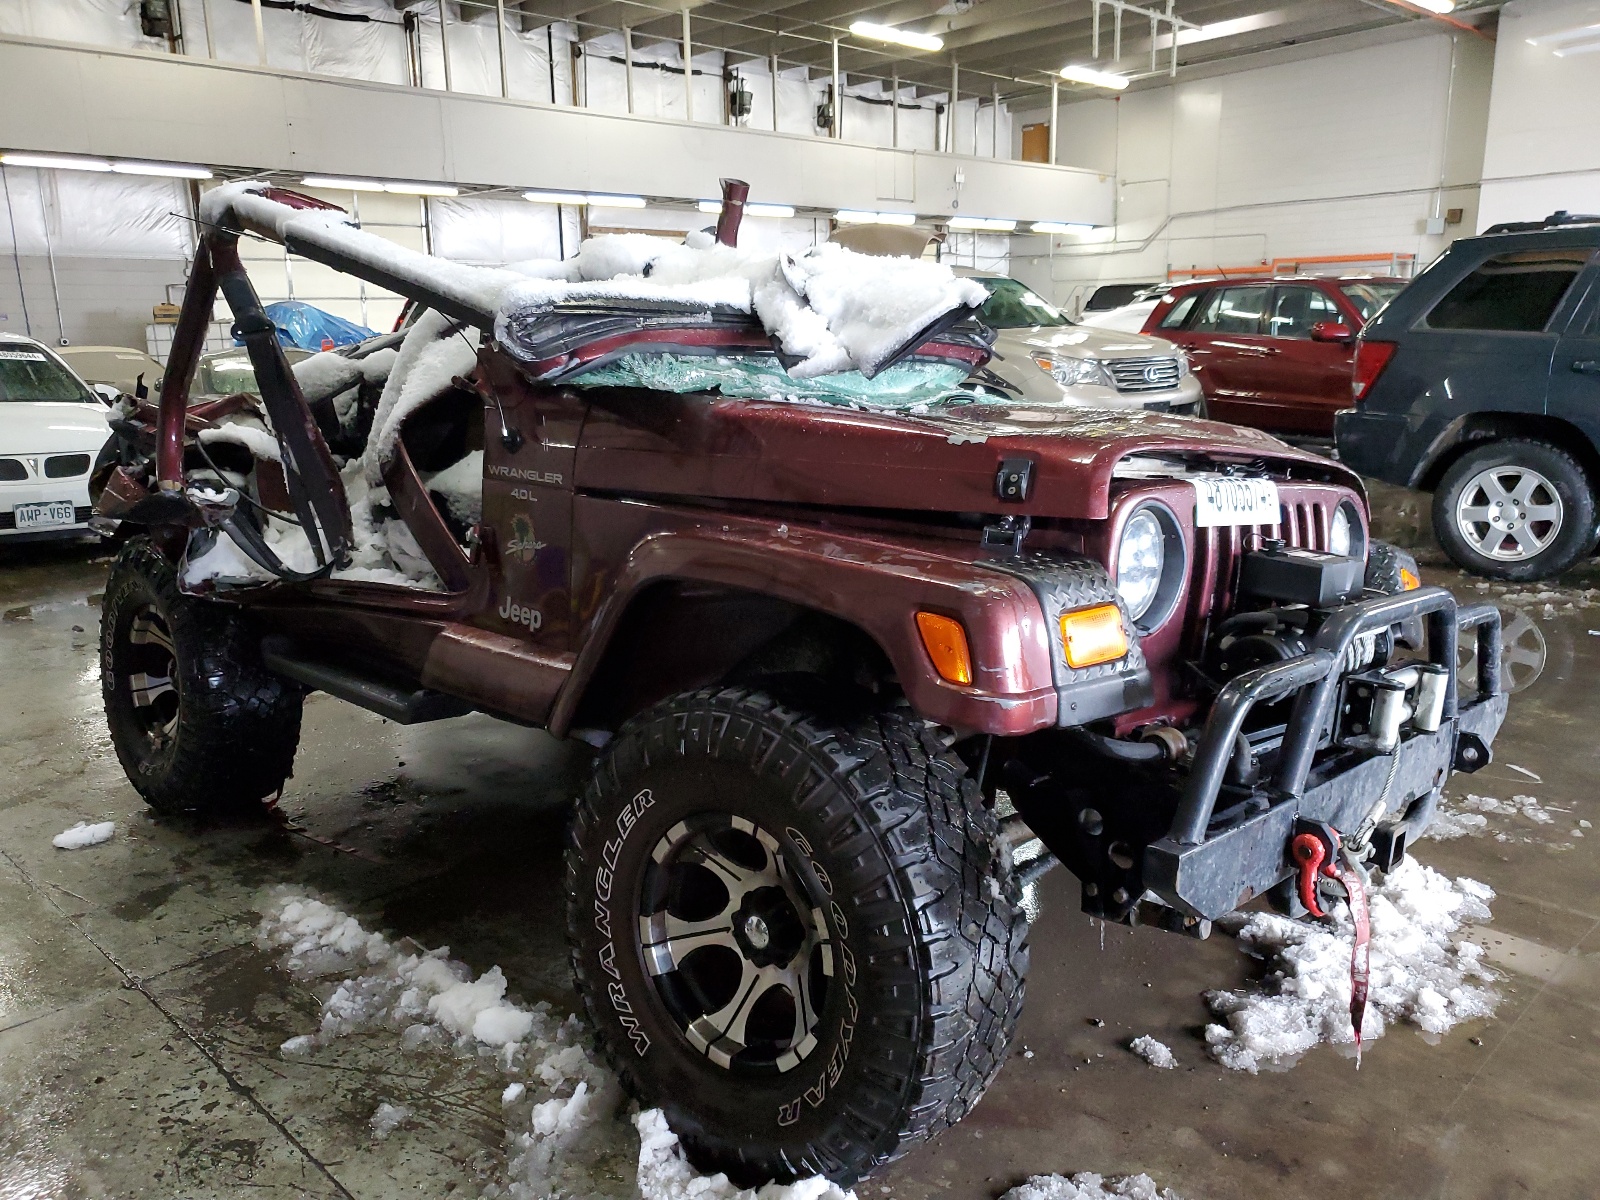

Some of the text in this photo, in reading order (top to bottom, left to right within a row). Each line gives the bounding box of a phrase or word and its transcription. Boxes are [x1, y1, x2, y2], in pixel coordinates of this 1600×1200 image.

[488, 464, 563, 485] WRANGLER
[499, 596, 542, 632] Jeep
[594, 788, 656, 1057] WRANGLER
[778, 826, 860, 1127] GOODYEAR
